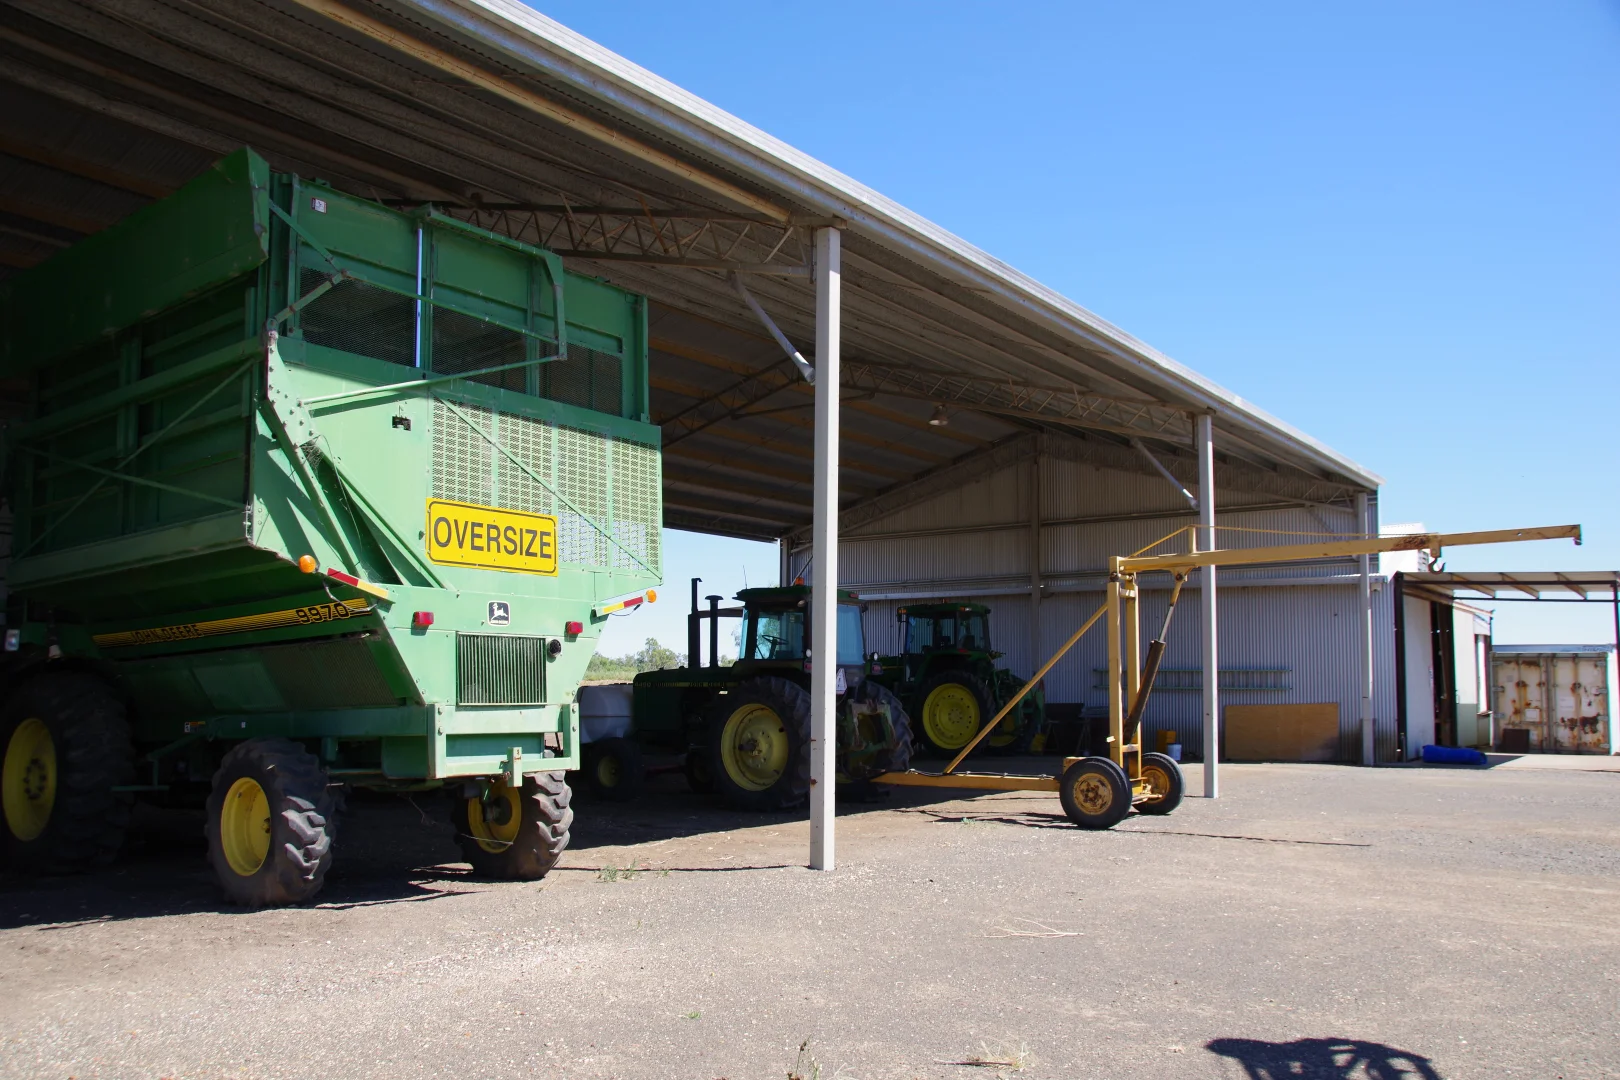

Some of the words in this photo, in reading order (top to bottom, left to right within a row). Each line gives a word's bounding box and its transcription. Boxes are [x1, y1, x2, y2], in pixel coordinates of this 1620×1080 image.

[433, 516, 552, 559] OVERSIZE
[130, 629, 161, 643] JOHN
[161, 623, 202, 641] DEERE
[295, 602, 350, 623] 9970
